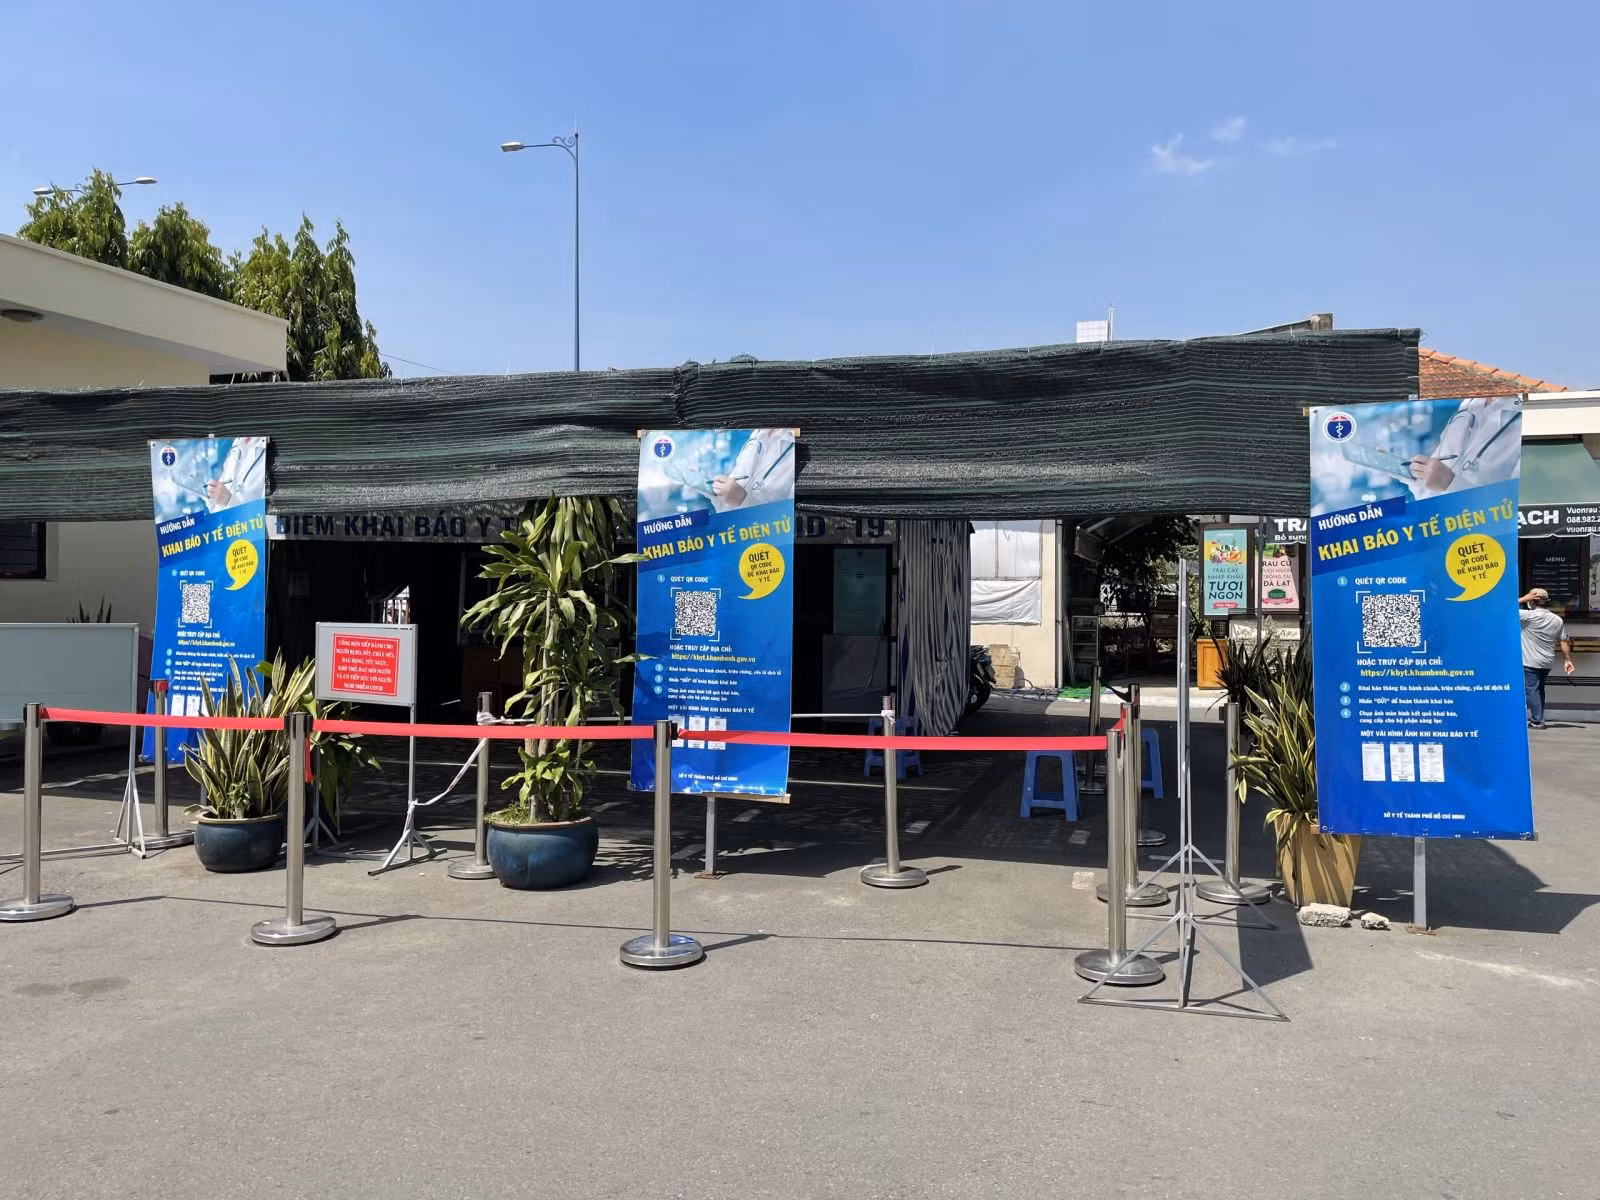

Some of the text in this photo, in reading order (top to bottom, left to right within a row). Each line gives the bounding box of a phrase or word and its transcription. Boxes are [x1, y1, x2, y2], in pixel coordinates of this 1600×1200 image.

[345, 516, 404, 537] KHAI
[415, 510, 467, 537] BÁO
[476, 517, 491, 537] Y
[644, 515, 692, 535] HƯỚNG DẪN
[1318, 505, 1383, 531] HƯỚNG DẪN
[160, 516, 195, 535] HƯỚNG DẪN
[1318, 498, 1514, 561] KHAI BÁO Y TẾ ĐIỆN TỬ
[162, 514, 263, 558] KHAI BÁO Y TẾ ĐIỆN TỬ
[643, 514, 791, 560] KHAI BÁO Y TẾ ĐIỆN TỬ
[749, 549, 769, 563] QUÉT
[1458, 542, 1485, 557] QUÉT
[1460, 554, 1489, 566] QR CODE
[1468, 565, 1483, 573] KHAI
[1209, 581, 1243, 591] TƯƠI
[1355, 576, 1374, 585] QUÉT
[1376, 577, 1385, 585] QR
[1209, 592, 1244, 600] NGON
[1357, 658, 1376, 667] HOẶC
[1399, 657, 1414, 667] CẬP
[1416, 659, 1427, 667] ĐỊA
[1361, 730, 1374, 738] MỘT
[1470, 730, 1479, 738] TẾ
